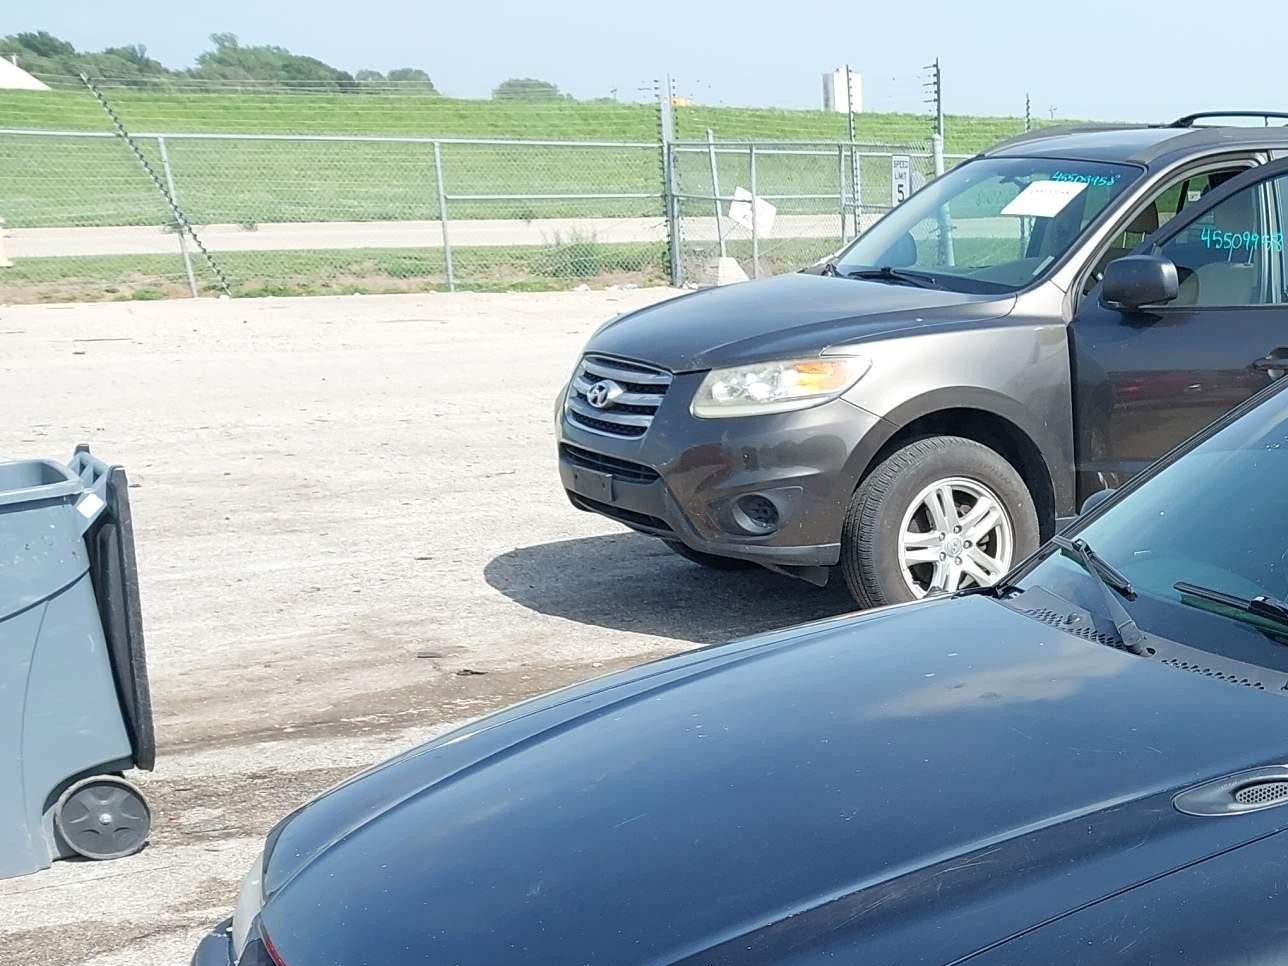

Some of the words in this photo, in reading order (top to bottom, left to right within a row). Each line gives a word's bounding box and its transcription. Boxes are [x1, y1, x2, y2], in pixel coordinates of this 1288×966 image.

[893, 160, 909, 169] SPEED
[897, 184, 905, 203] 5
[1201, 227, 1284, 252] 45509958
